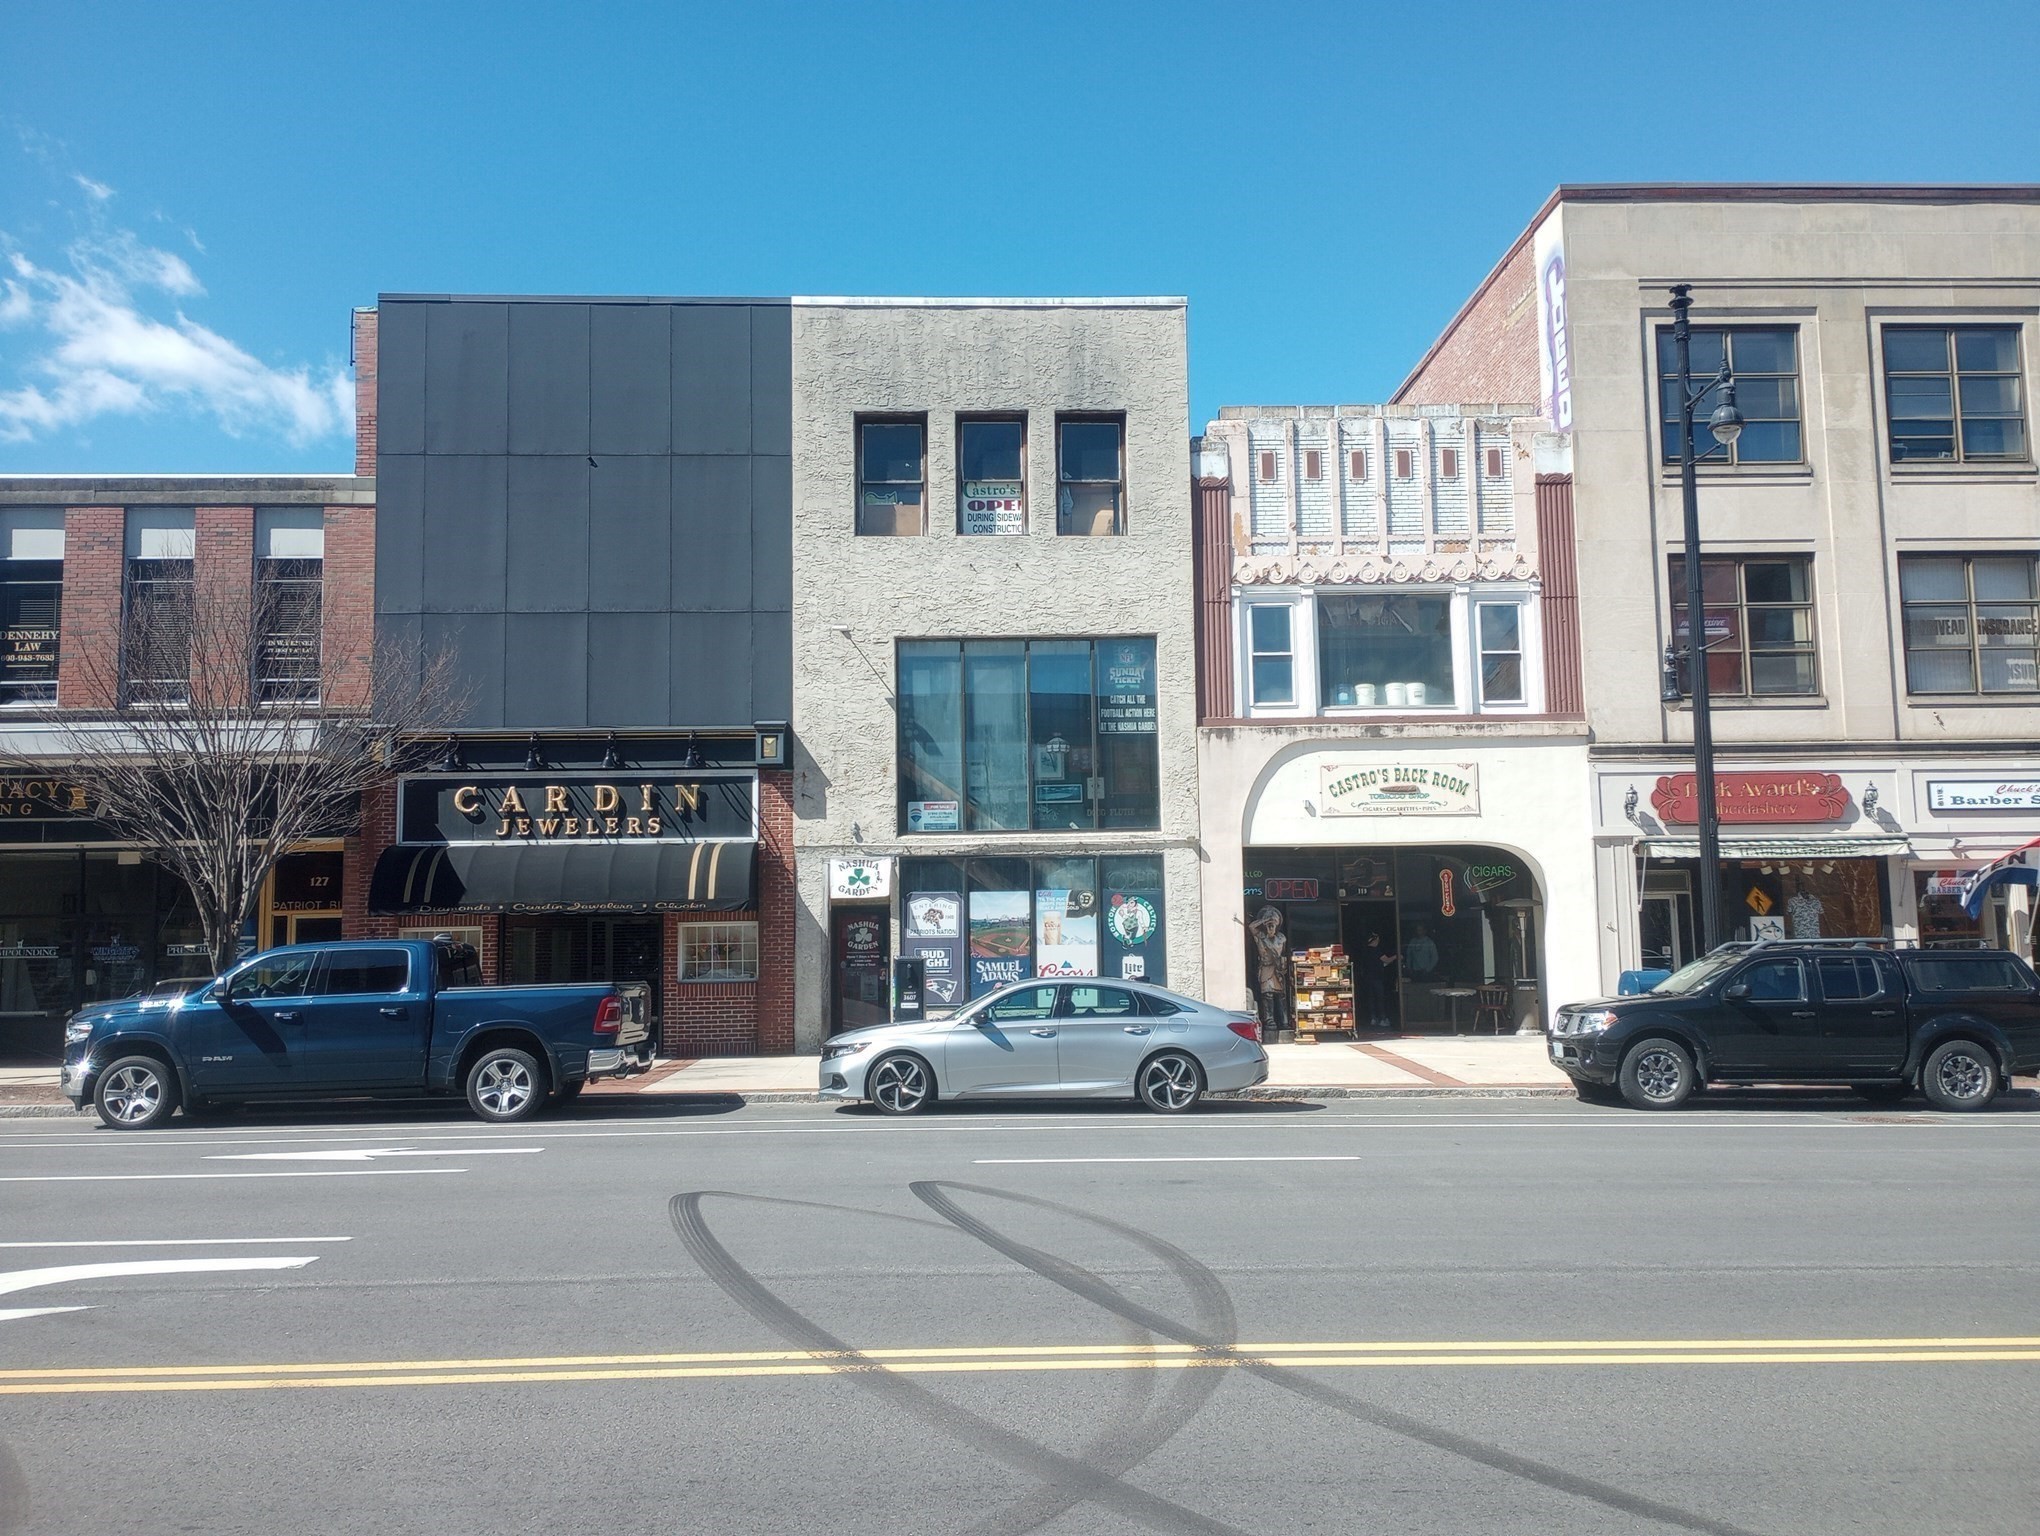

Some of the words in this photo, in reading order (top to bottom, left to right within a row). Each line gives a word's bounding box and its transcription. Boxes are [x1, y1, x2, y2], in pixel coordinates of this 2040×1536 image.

[964, 481, 1016, 498] Castro's
[967, 513, 994, 522] DURING
[1977, 618, 2038, 635] INSURANCE
[14, 642, 41, 651] LAW
[1110, 667, 1146, 680] SUNDAY
[1109, 694, 1126, 704] CATCH
[1127, 694, 1136, 704] ALL
[1136, 694, 1146, 704] THE
[1100, 708, 1124, 717] FOOTBALL
[1125, 708, 1142, 717] ACTION
[1143, 708, 1156, 717] HERE
[1100, 722, 1107, 731] AT
[1108, 722, 1117, 731] THE
[1117, 722, 1137, 731] NASHUA
[1328, 768, 1389, 798] CASTRO'S
[1393, 767, 1429, 784] BACK
[1432, 771, 1471, 797] ROOM
[453, 784, 700, 813] CARDIN
[1368, 792, 1405, 800] TOBACCO
[1408, 792, 1431, 800] SHOP
[1950, 795, 2023, 806] Barber
[1715, 802, 1798, 816] berdashery
[495, 817, 661, 837] JEWELERS
[838, 859, 879, 871] NASHUA
[1472, 865, 1512, 877] CIGARS
[310, 876, 330, 887] 127
[1266, 880, 1318, 898] OPEN
[1931, 886, 1961, 894] BARBER
[272, 901, 322, 910] PATRIOT
[566, 902, 633, 911] Jewelers
[1143, 900, 1158, 932] CELTICS
[847, 920, 879, 931] NASHUA
[1107, 906, 1121, 938] BOSTON
[847, 940, 879, 951] GARDEN
[921, 950, 946, 959] BUD
[926, 959, 949, 968] GHT
[976, 960, 1024, 973] SAMUEL
[1124, 963, 1142, 975] Lite
[980, 971, 1020, 983] ADAMS
